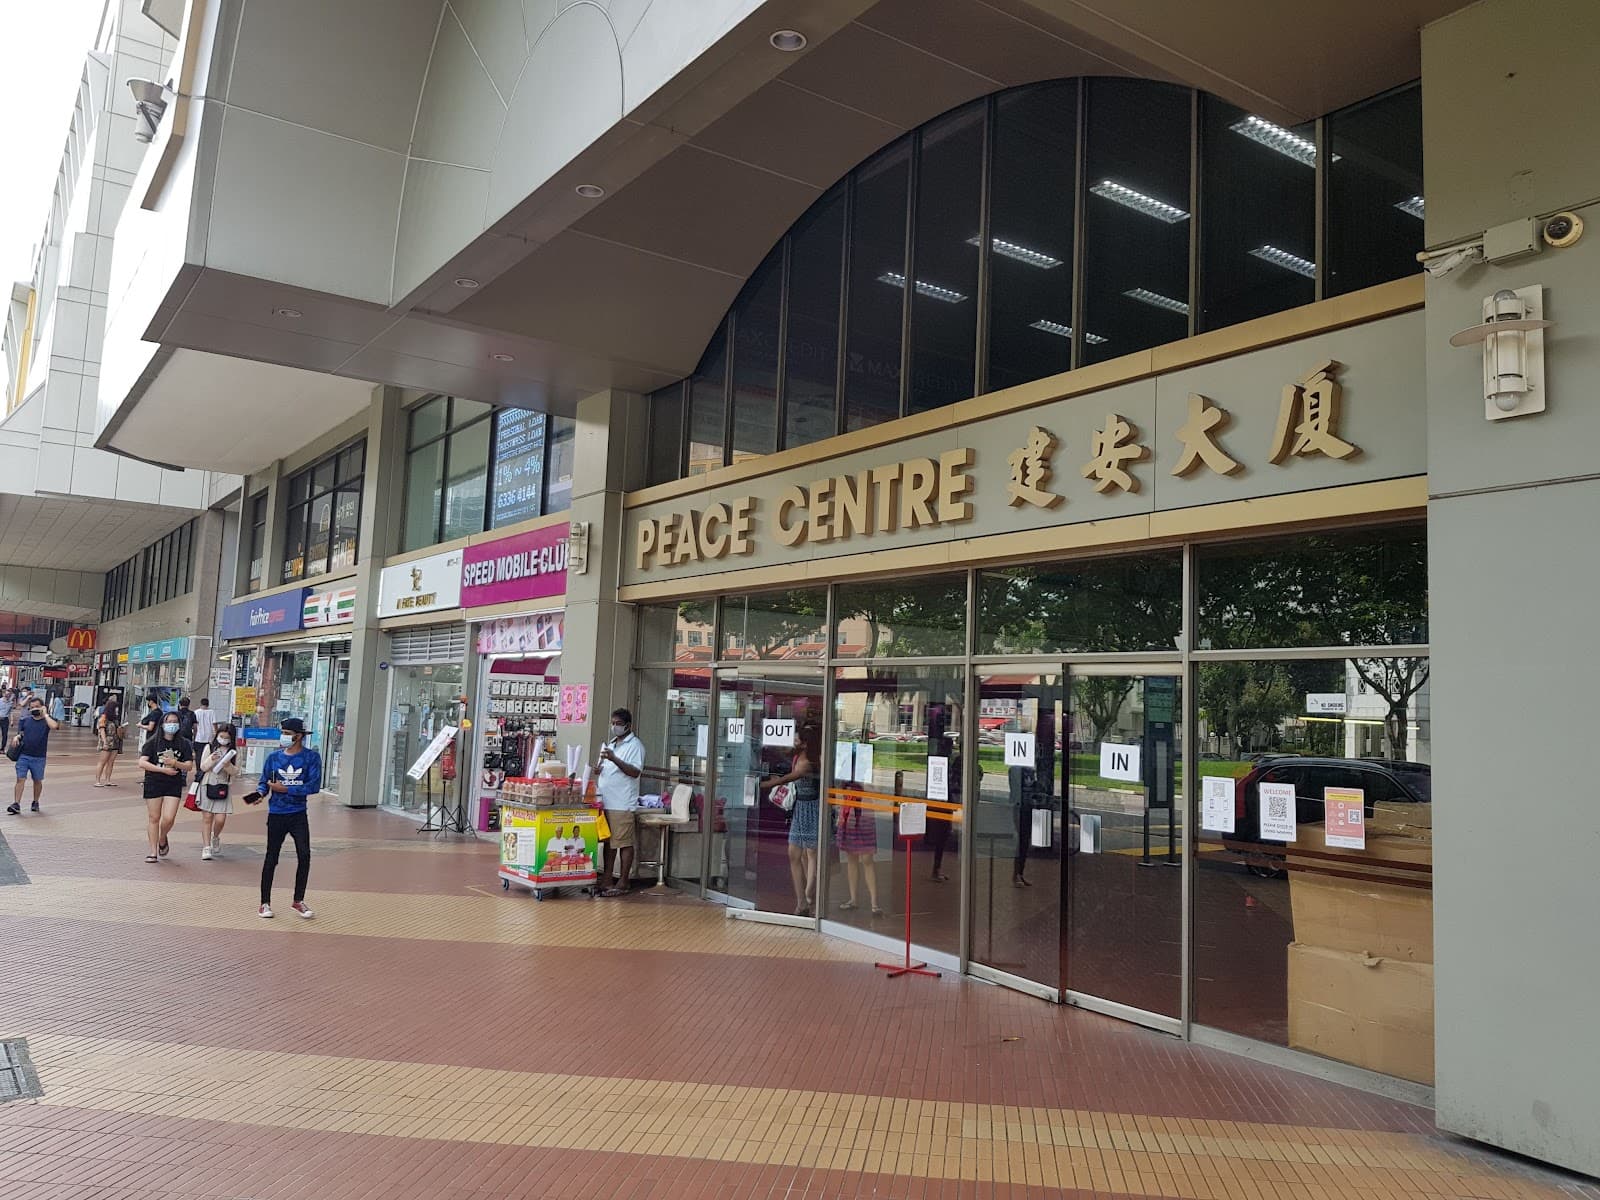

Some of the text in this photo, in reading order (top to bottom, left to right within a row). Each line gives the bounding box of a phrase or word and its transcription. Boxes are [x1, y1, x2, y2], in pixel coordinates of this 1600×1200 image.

[635, 447, 976, 570] PEACE CENTRE
[463, 559, 495, 587] SPEED
[729, 723, 744, 735] OUT
[764, 724, 793, 737] OUT
[1013, 740, 1027, 758] IN
[1111, 752, 1129, 771] IN
